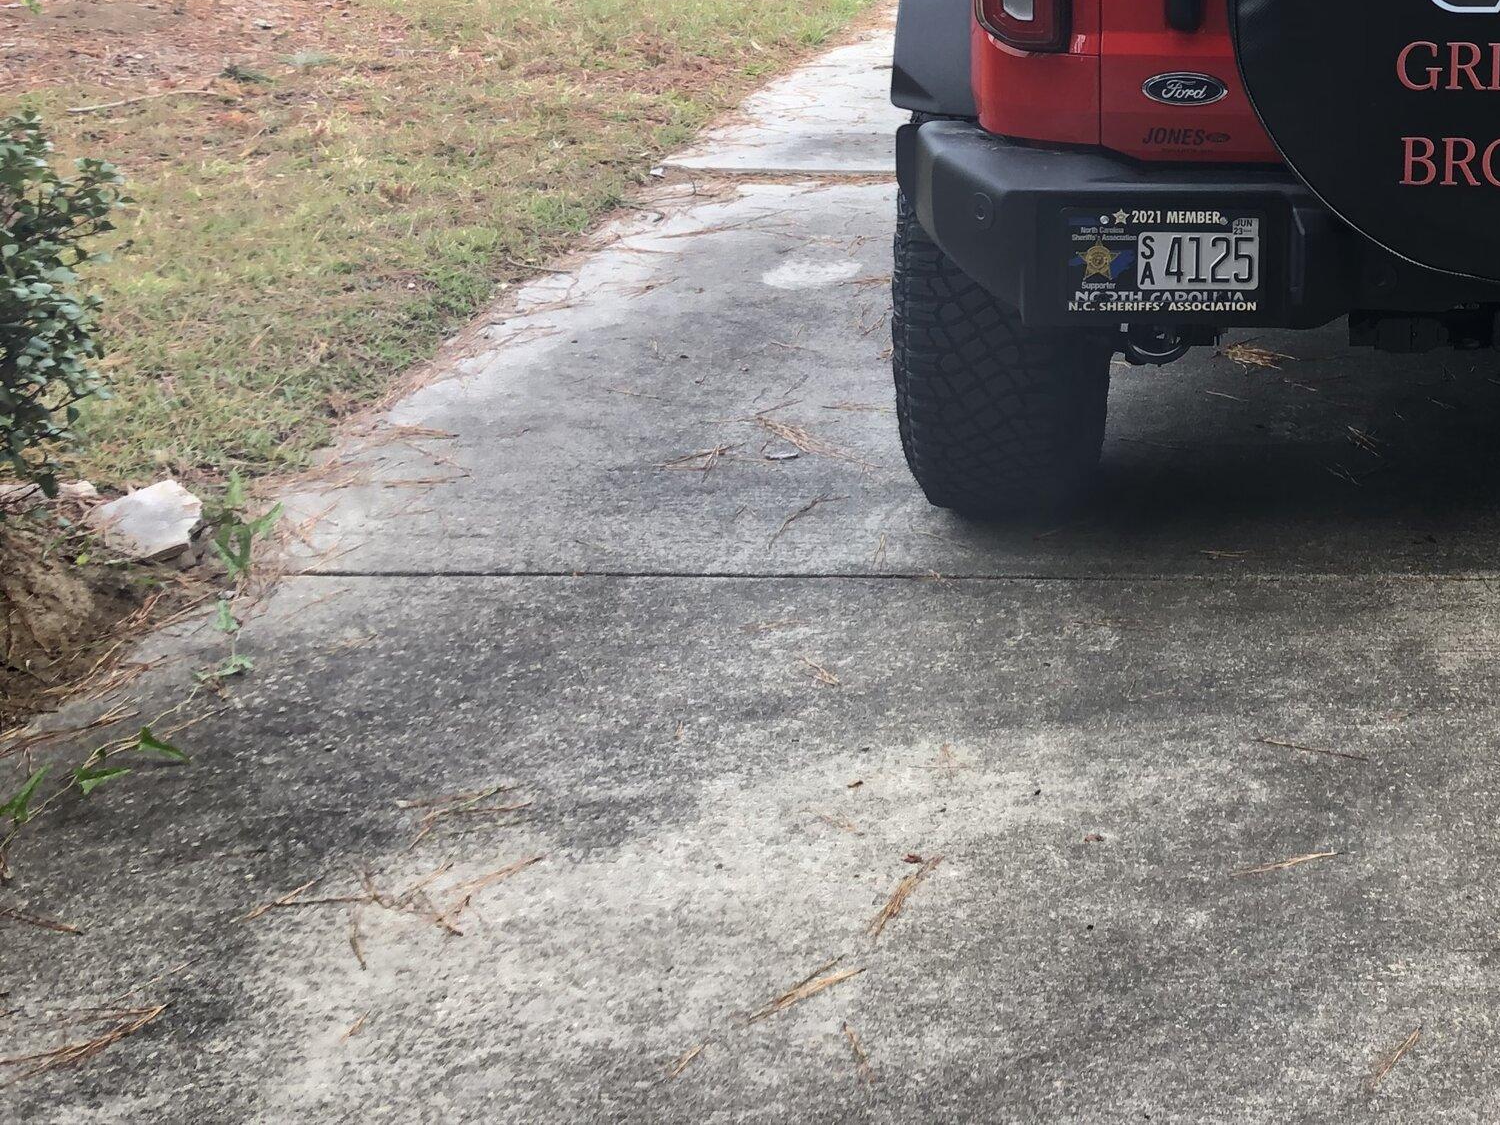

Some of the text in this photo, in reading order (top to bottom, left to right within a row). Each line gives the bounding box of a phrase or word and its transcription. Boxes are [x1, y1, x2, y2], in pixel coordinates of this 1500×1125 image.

[1161, 79, 1208, 99] Ford
[1142, 127, 1206, 146] JONES
[1132, 210, 1221, 224] 2021 MEMBER
[1236, 219, 1253, 227] JUN
[1233, 227, 1243, 235] 23
[1164, 236, 1254, 284] 4125
[1081, 281, 1117, 291] Supporter
[1068, 301, 1096, 311] N.C.
[1168, 301, 1257, 311] ASSOCIATION
